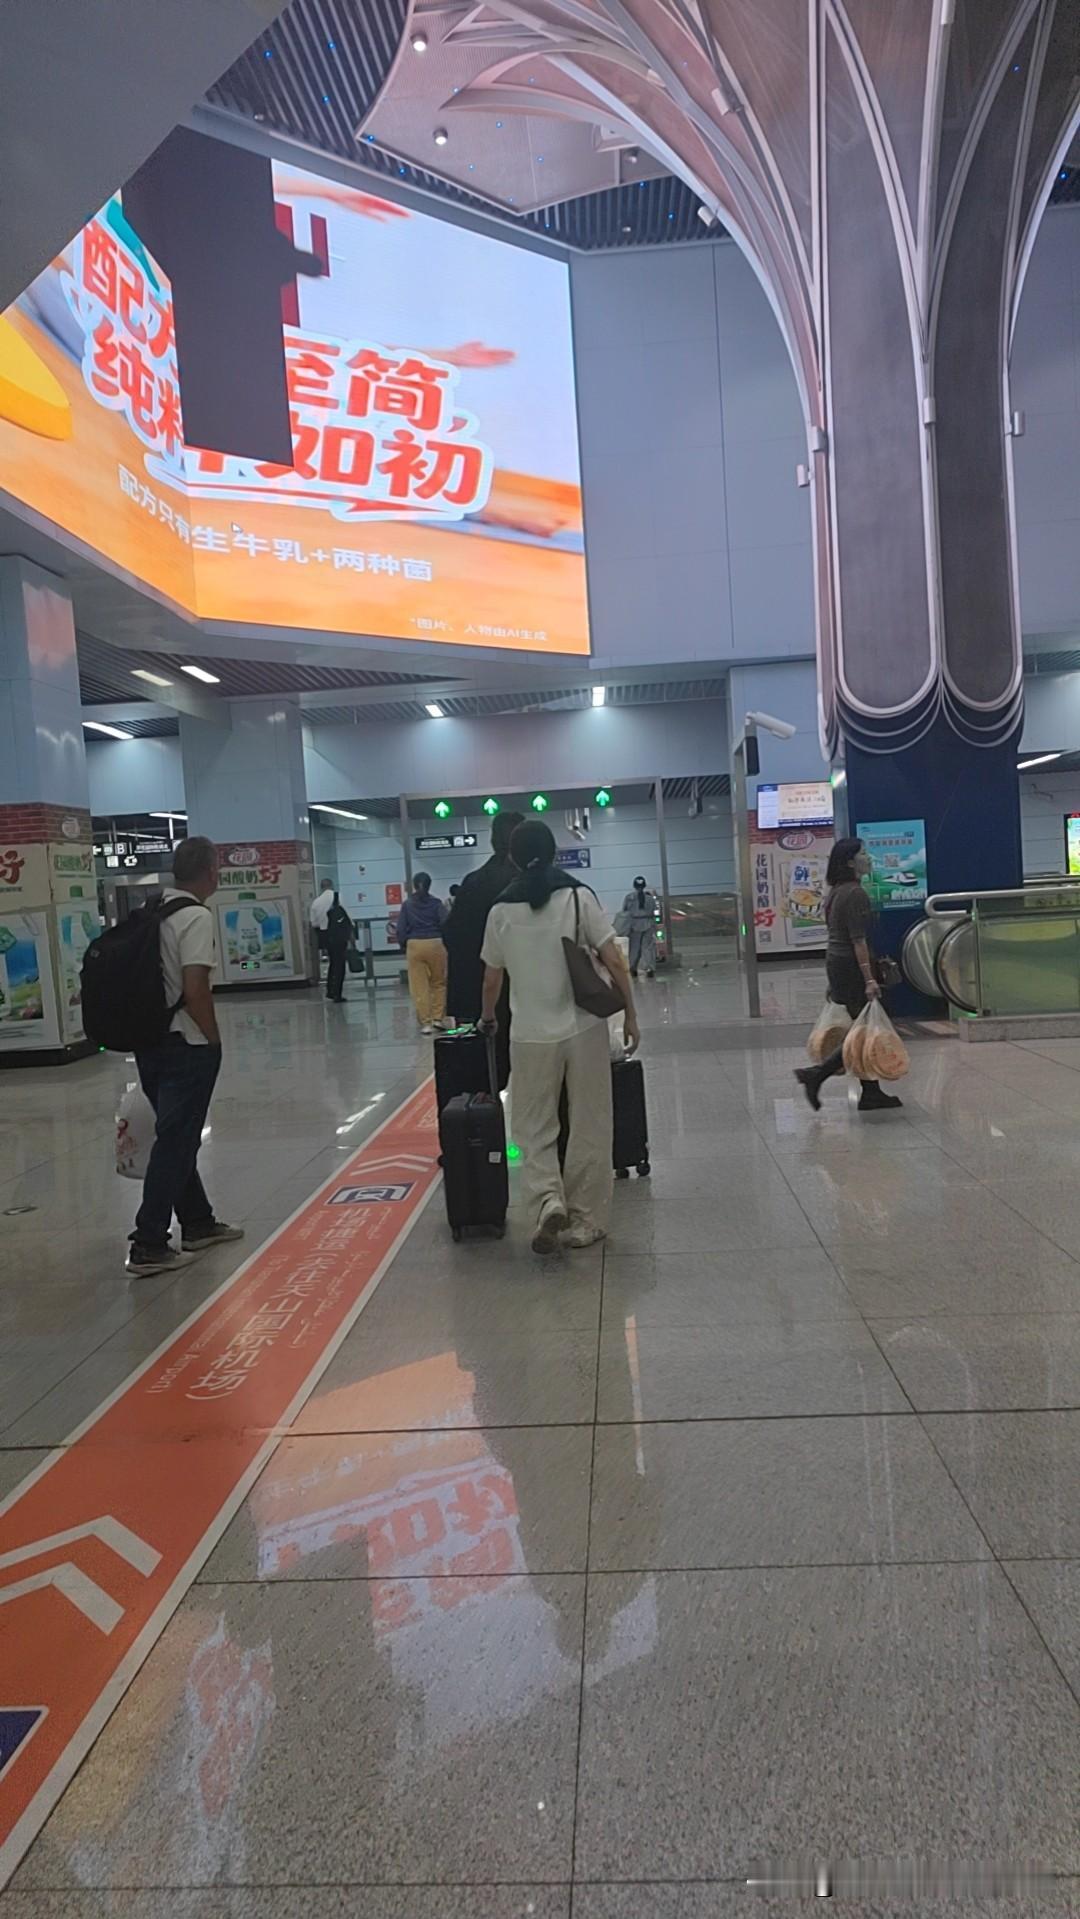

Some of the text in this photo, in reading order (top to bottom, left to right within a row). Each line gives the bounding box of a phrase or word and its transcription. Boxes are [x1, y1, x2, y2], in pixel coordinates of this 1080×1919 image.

[118, 463, 433, 582] 配方只有生牛乳+两种菌
